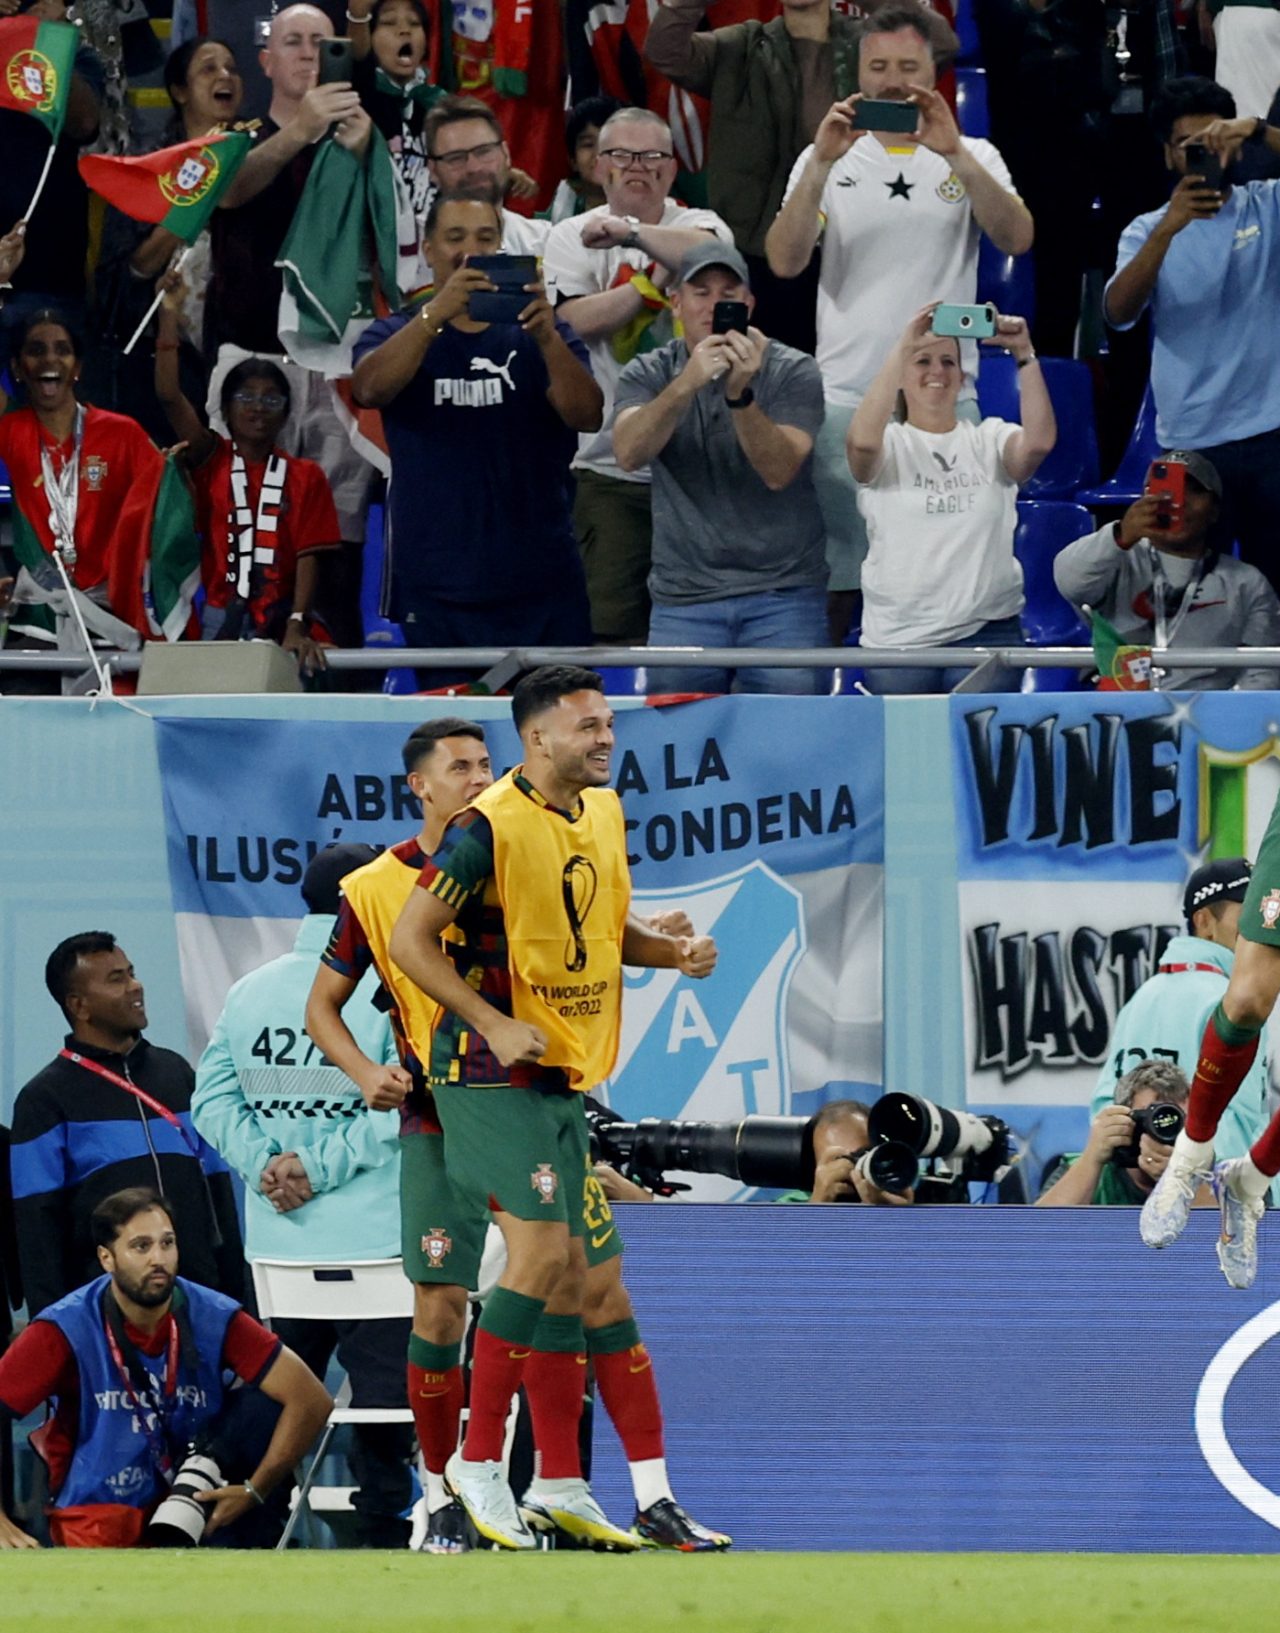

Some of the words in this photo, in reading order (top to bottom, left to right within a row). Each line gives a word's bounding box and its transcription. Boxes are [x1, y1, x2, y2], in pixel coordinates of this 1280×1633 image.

[434, 378, 503, 407] PUMA
[925, 493, 976, 514] EAGLE
[614, 750, 649, 797] A
[664, 737, 730, 790] LA
[964, 706, 1182, 850] VINE
